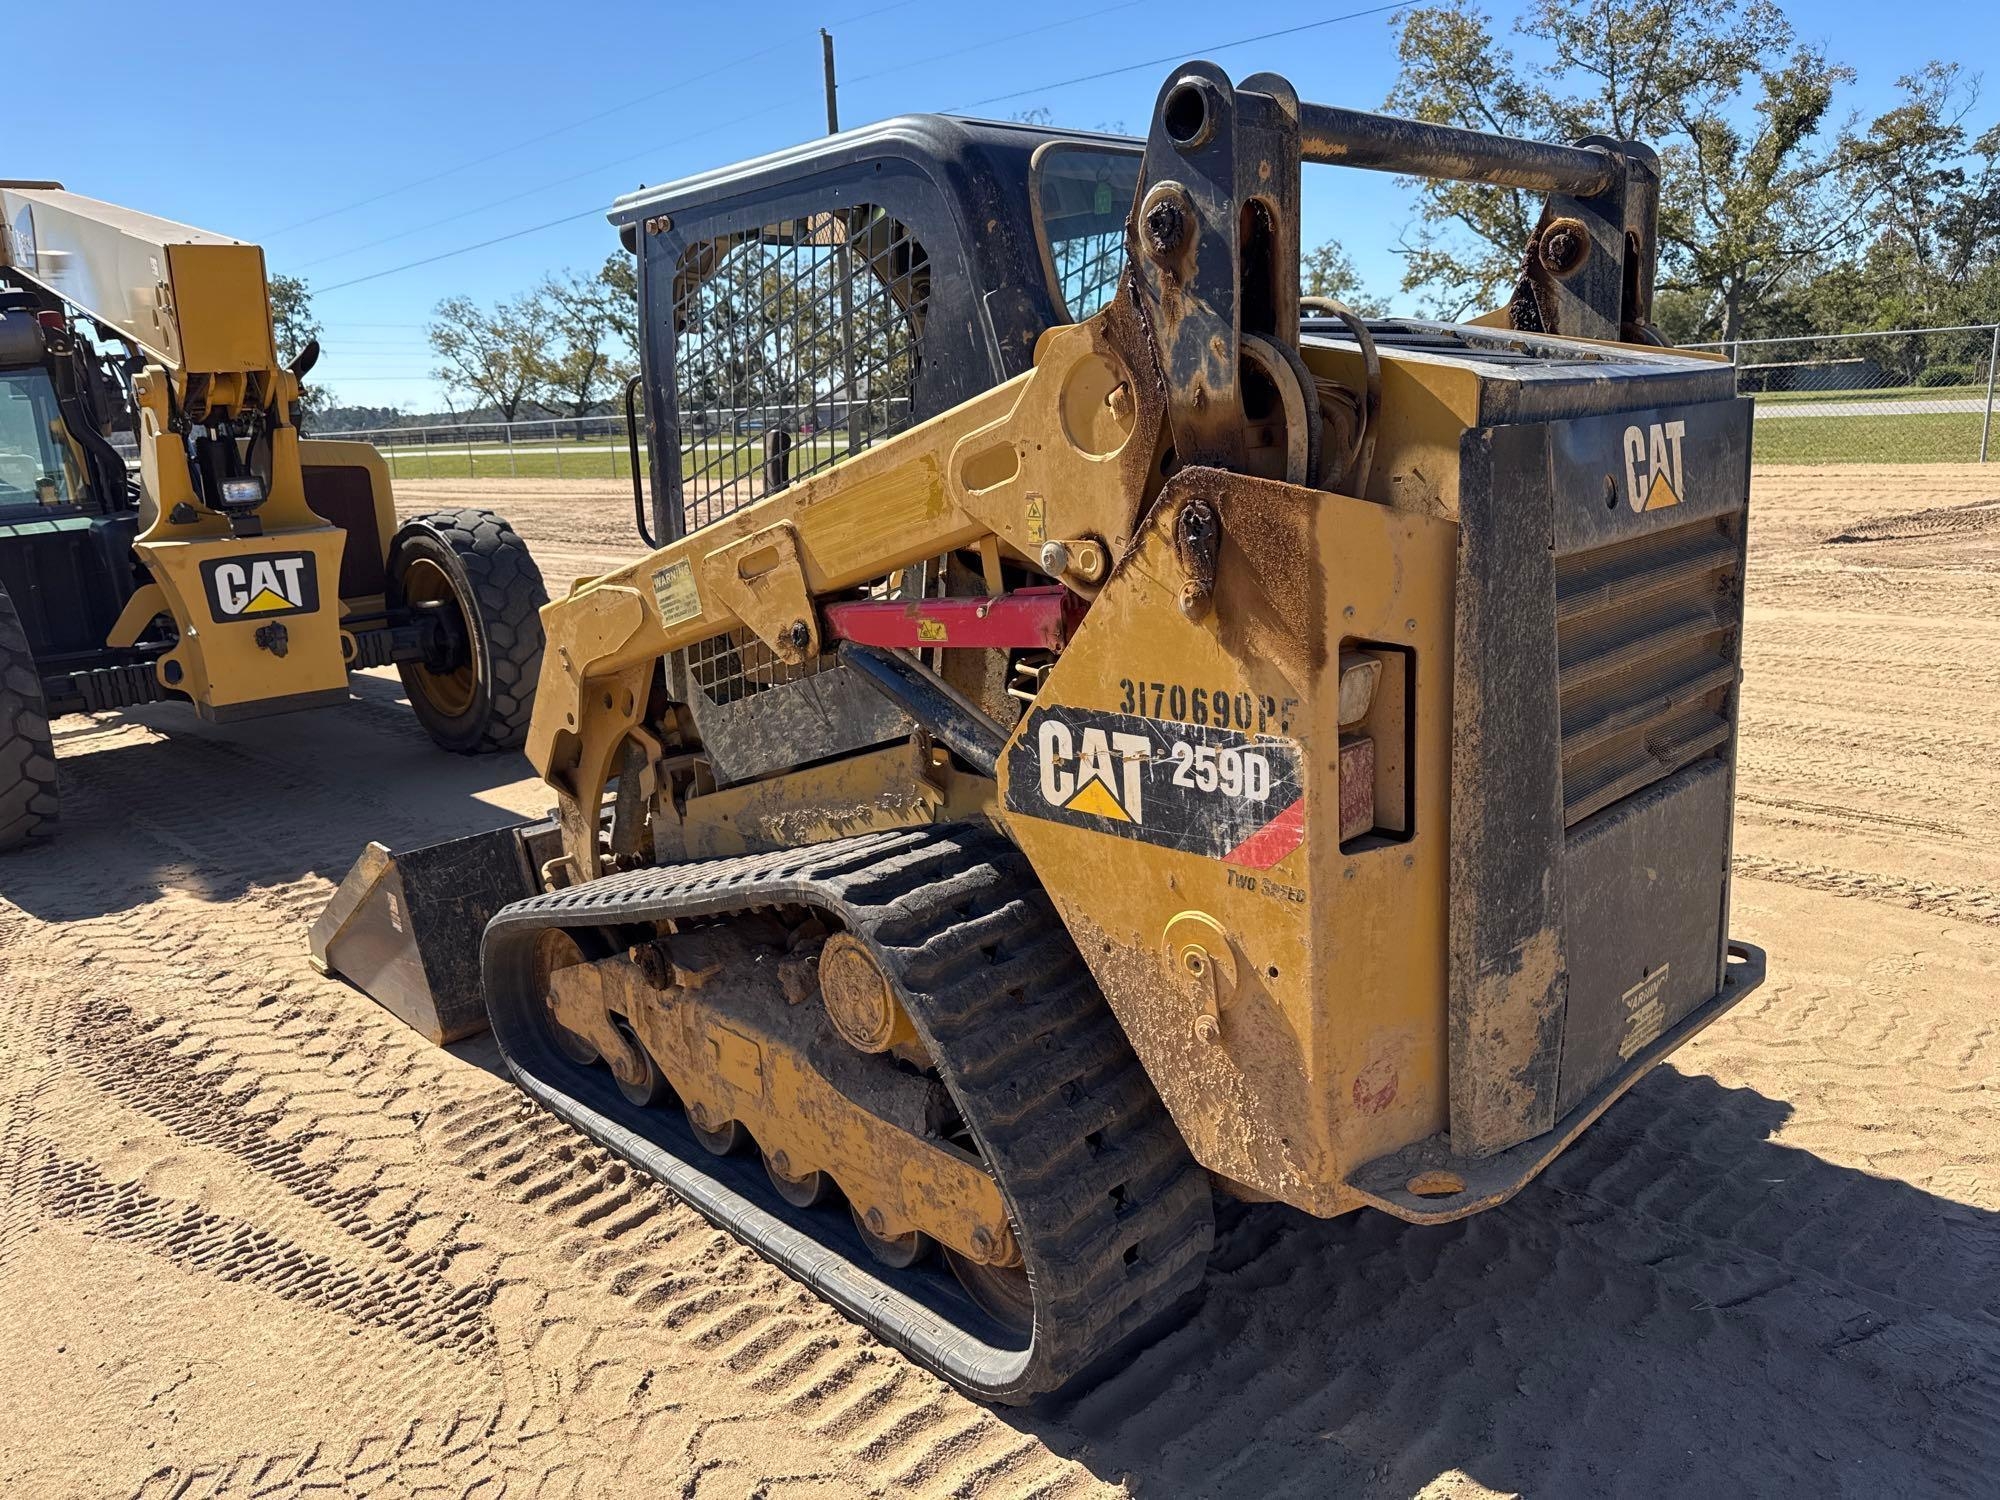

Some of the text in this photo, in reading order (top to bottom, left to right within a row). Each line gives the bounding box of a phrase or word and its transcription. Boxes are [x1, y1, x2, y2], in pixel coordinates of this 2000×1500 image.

[1624, 420, 1685, 513] CAT
[214, 558, 304, 614] CAT
[654, 564, 690, 588] WARNING
[1038, 719, 1270, 825] CAT 259D
[1227, 869, 1257, 891] TWO
